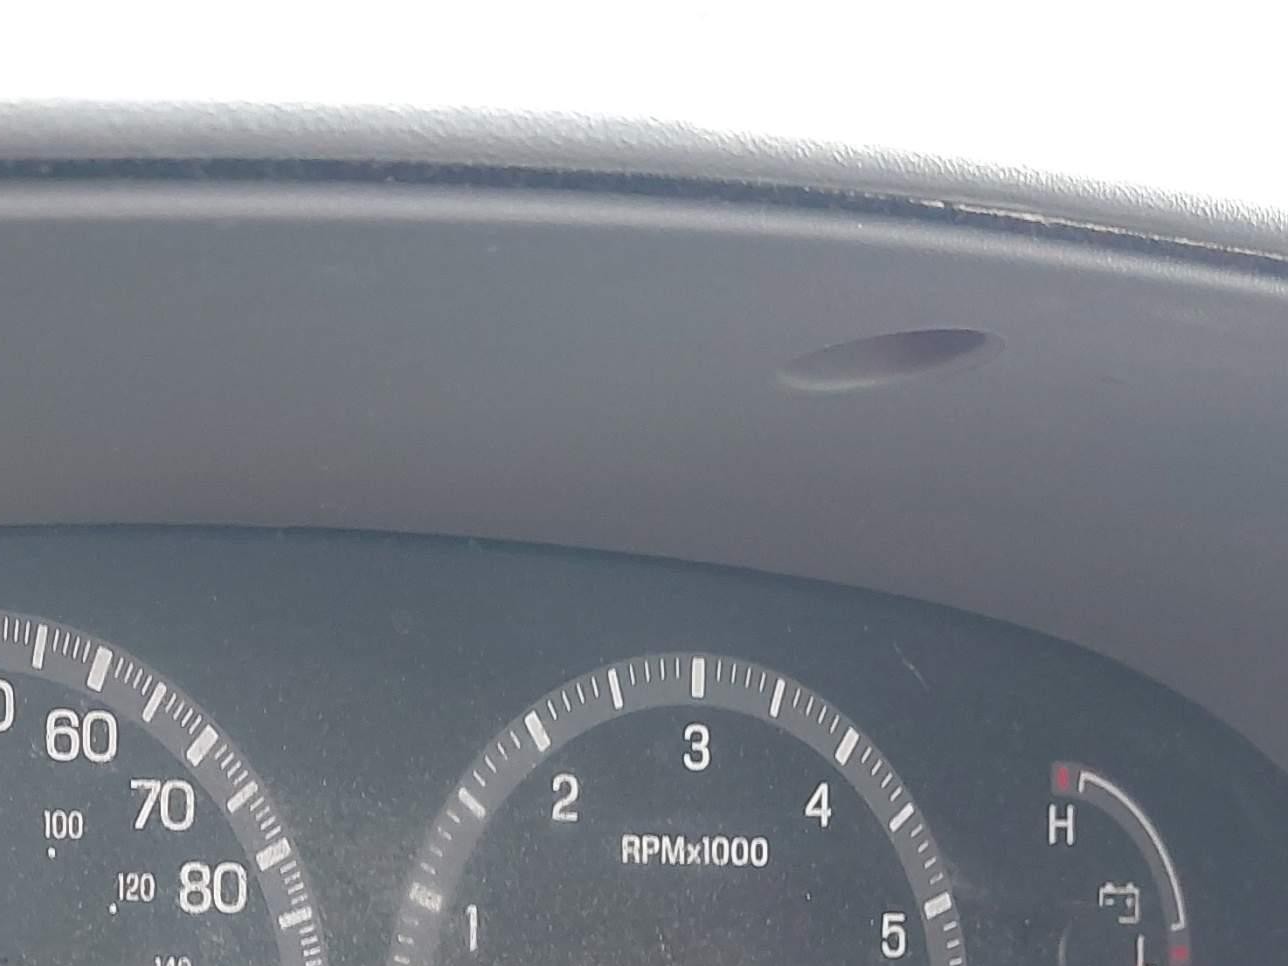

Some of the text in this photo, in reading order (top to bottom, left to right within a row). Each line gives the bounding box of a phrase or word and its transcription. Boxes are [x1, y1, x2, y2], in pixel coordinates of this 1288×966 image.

[45, 708, 118, 762] 60
[683, 724, 710, 770] 3
[130, 779, 195, 831] 70
[551, 773, 579, 822] 2
[805, 782, 832, 828] 4
[43, 810, 83, 841] 100
[1048, 804, 1074, 845] H
[621, 834, 769, 868] RPMx1000
[117, 872, 155, 903] 120
[178, 861, 248, 914] 80
[465, 904, 477, 951] 1
[881, 912, 907, 958] 5
